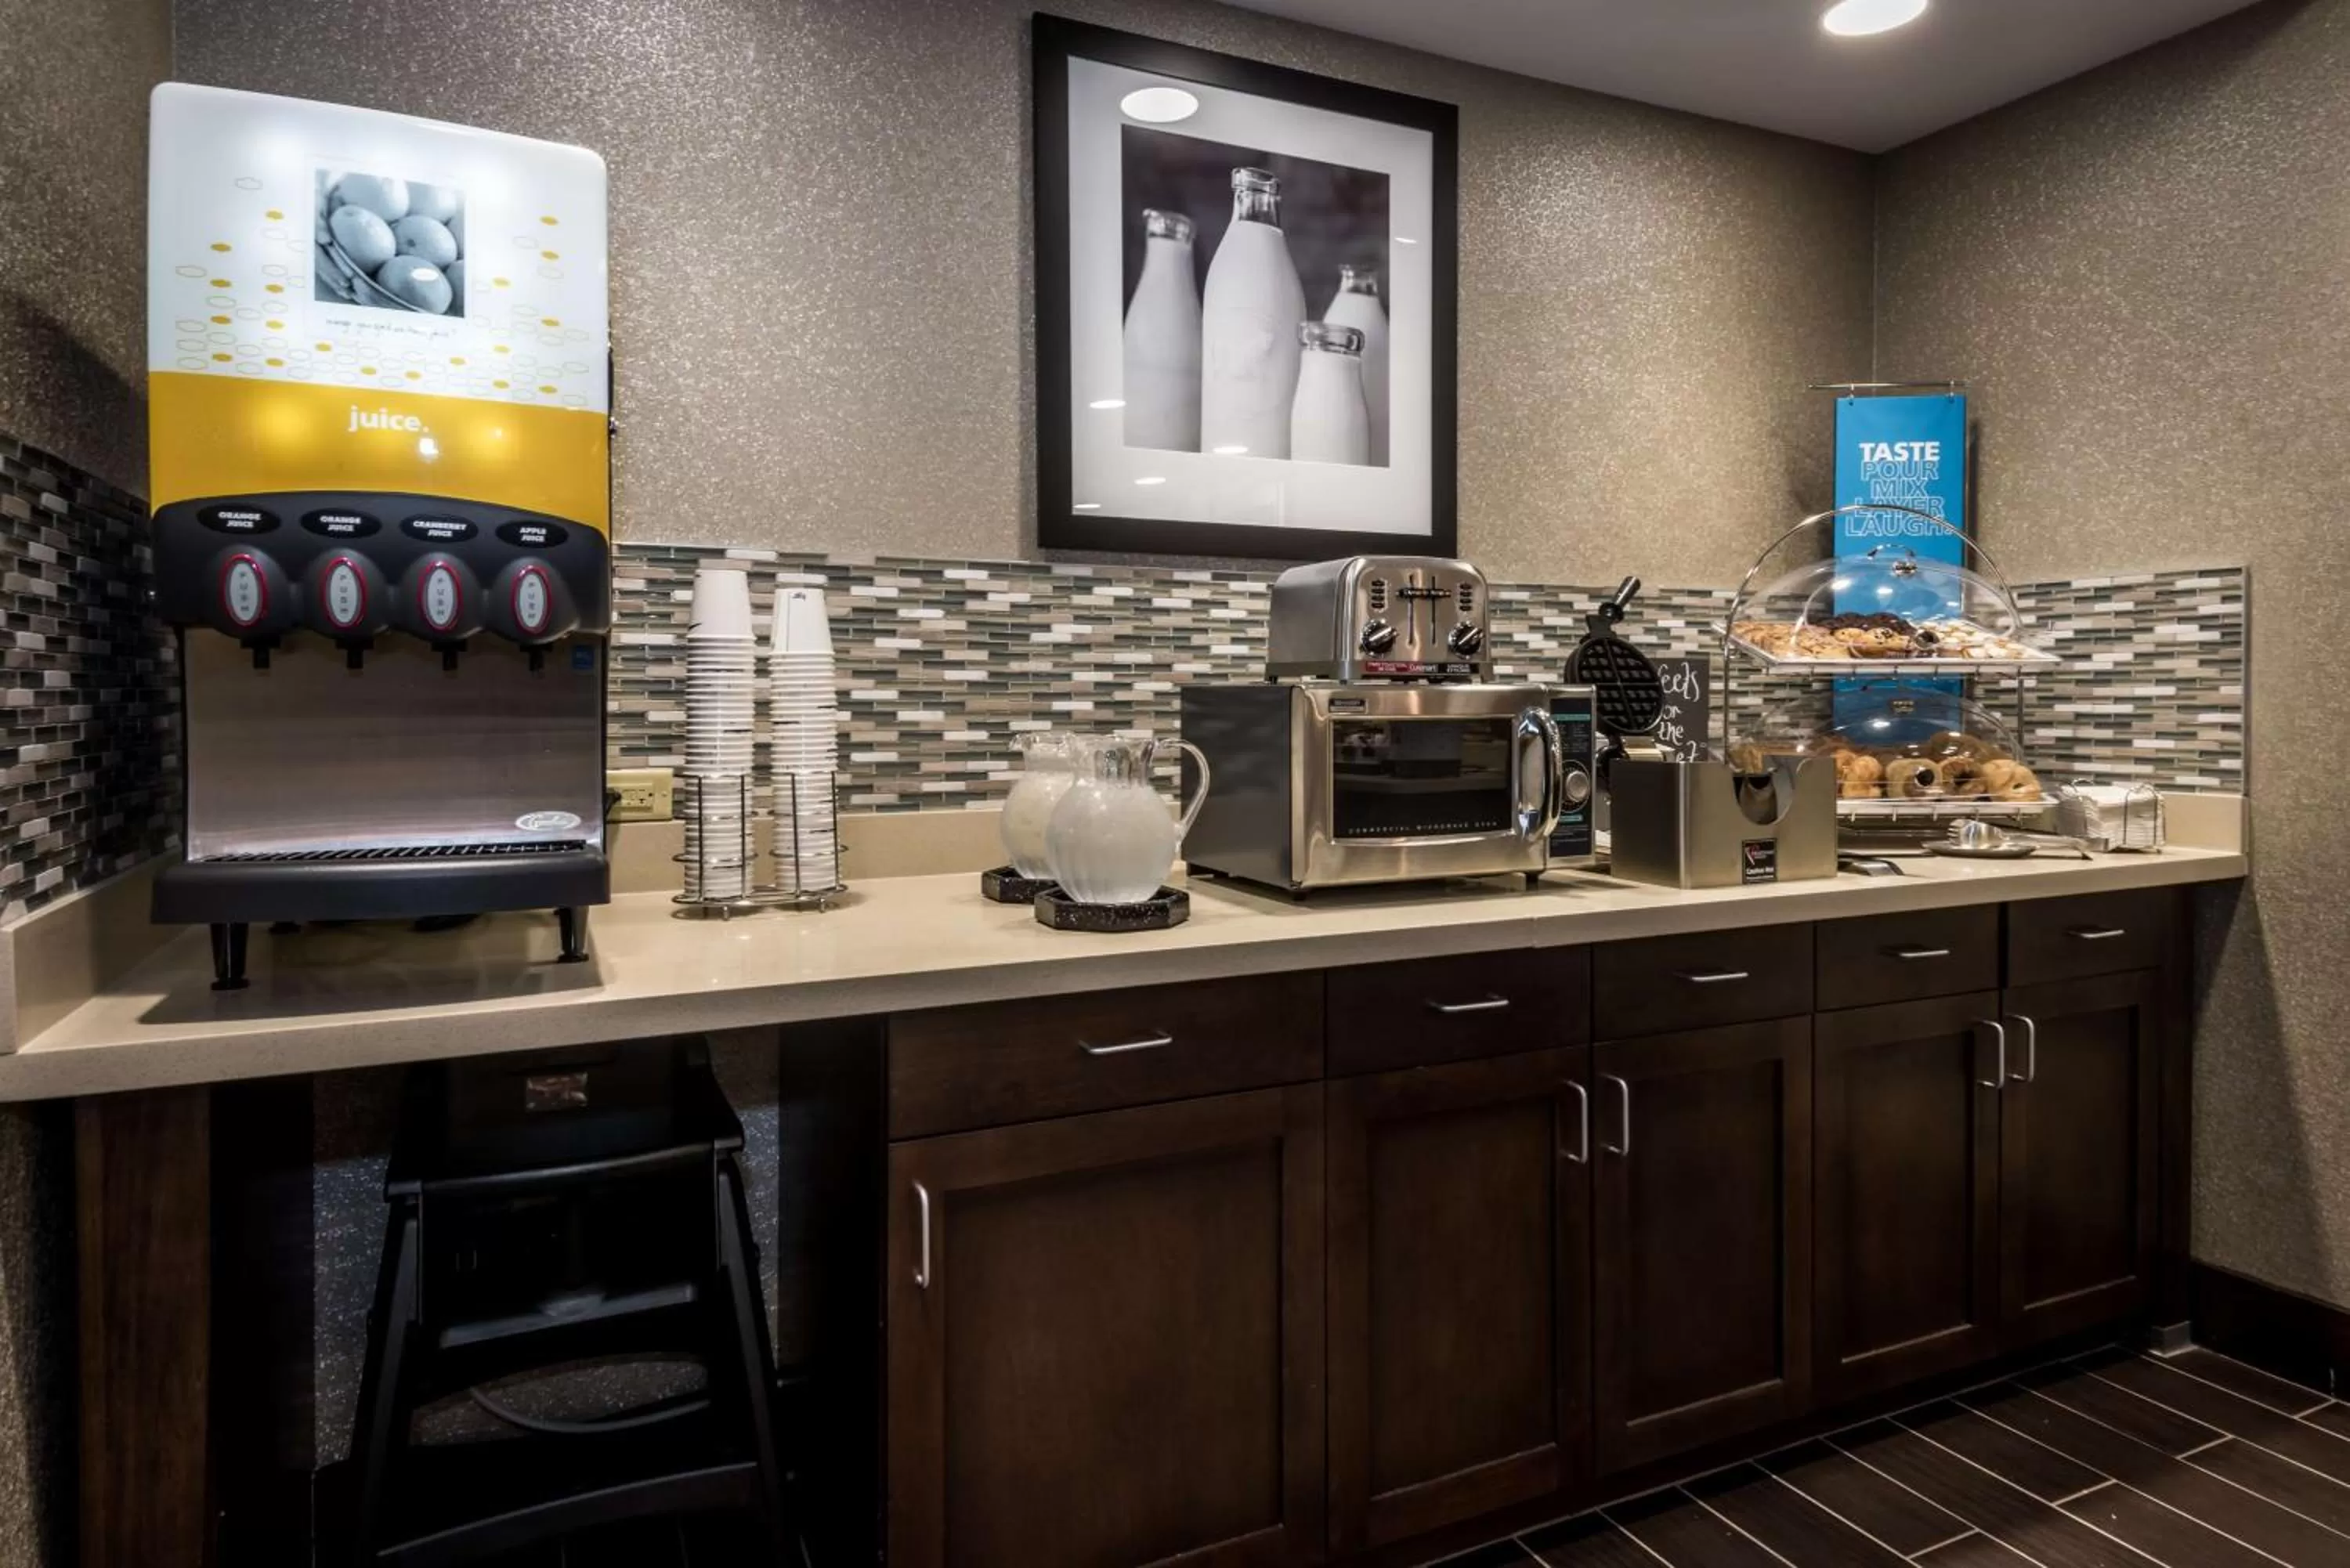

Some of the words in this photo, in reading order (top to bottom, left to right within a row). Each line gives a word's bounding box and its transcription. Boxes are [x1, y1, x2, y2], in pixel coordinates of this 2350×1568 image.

[348, 404, 429, 433] juice.
[1858, 441, 1940, 461] TASTE
[1860, 461, 1940, 481] POUR
[1871, 479, 1929, 499] MIX
[218, 511, 261, 521] ORANGE
[1854, 497, 1945, 518] LAYER
[226, 520, 255, 529] JUICE
[320, 515, 362, 525] ORANGE
[413, 520, 467, 531] CRANBERRY
[519, 526, 547, 535] APPLE
[1657, 721, 1685, 746] the
